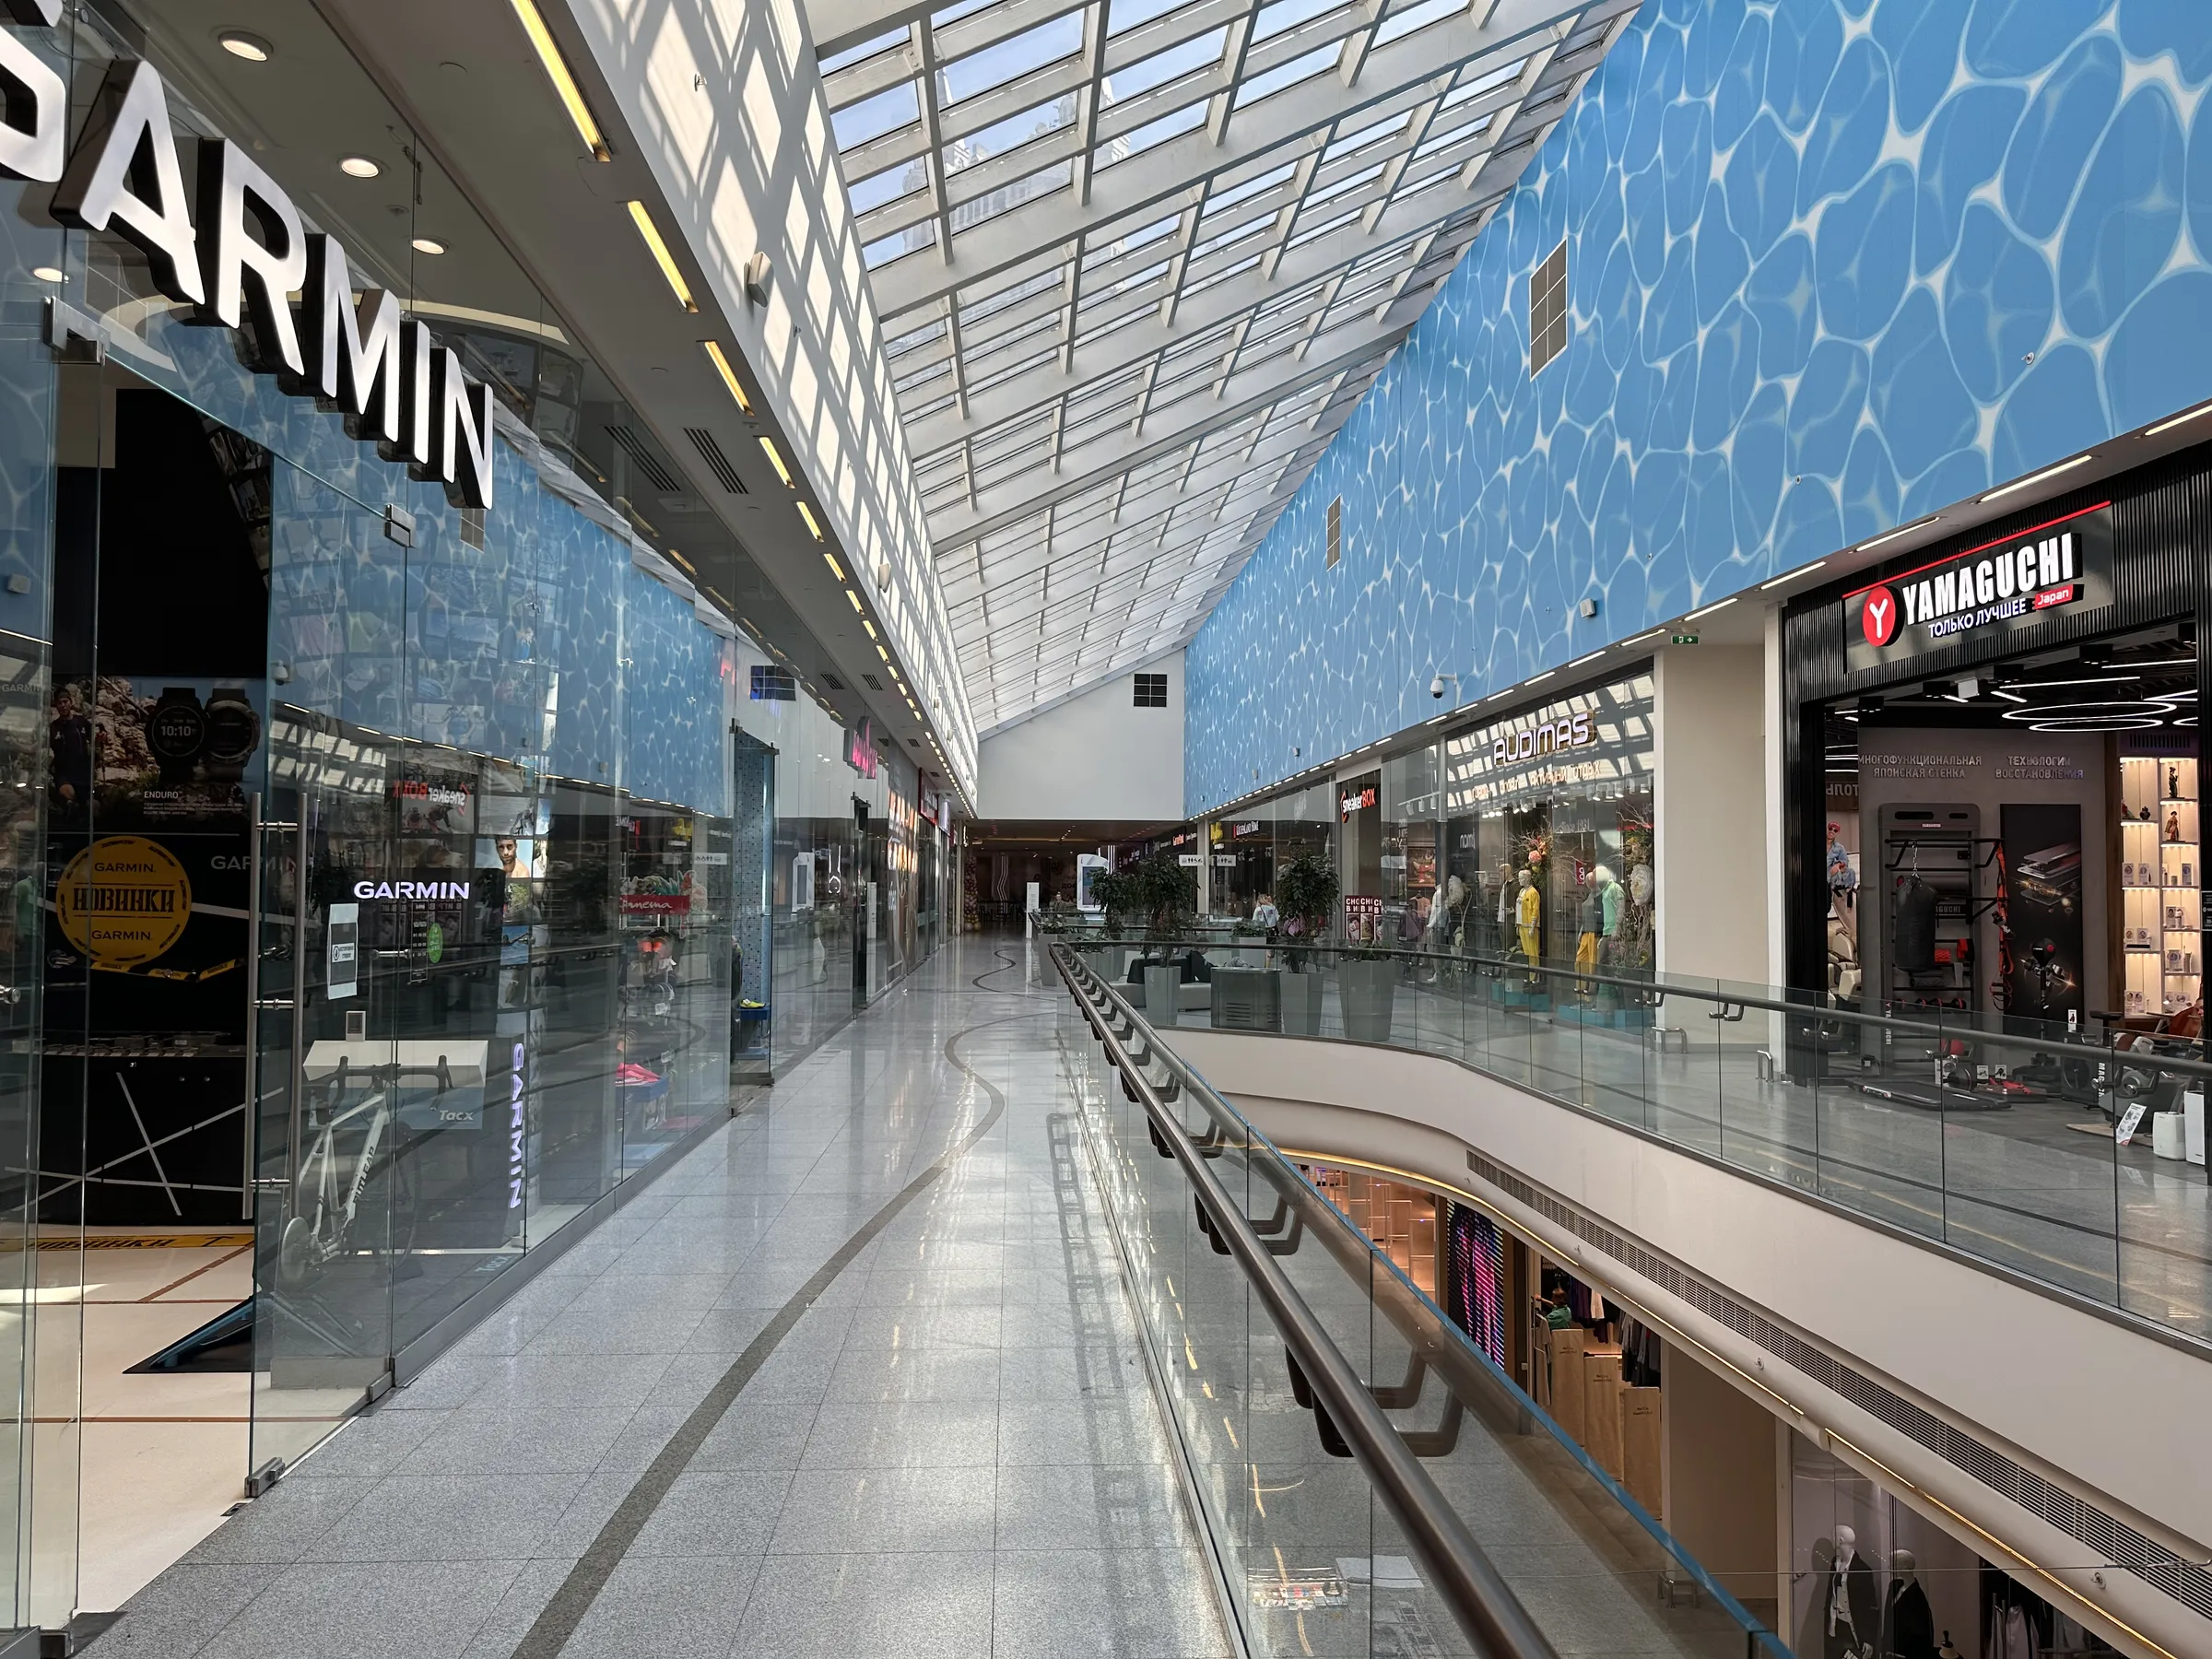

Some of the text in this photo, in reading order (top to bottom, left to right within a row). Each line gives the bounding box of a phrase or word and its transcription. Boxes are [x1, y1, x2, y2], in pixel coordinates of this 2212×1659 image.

[1901, 533, 2074, 625] YAMAGUCHI
[2037, 588, 2070, 606] Japan
[1927, 600, 2027, 639] ТОЛЬКО ЛУЧШЕЕ
[160, 725, 192, 736] 10:10
[1493, 712, 1590, 765] AUDIMAS
[1857, 754, 1982, 767] МНОГОФУНКЦИОНАЛЬНАЯ
[2007, 755, 2071, 767] ТЕХНОЛОГИИ
[1874, 768, 1966, 779] ЯПОНСКАЯ СТЕНКА
[1994, 769, 2084, 780] ВОССТАНОВЛЕНИЯ
[144, 791, 179, 799] ENDURO
[95, 863, 154, 873] GARMIN
[353, 881, 470, 900] GARMIN
[73, 888, 175, 912] НОВИНКИ
[91, 930, 151, 941] GARMIN
[439, 1110, 474, 1121] Tacx
[509, 1042, 524, 1208] GARMIN
